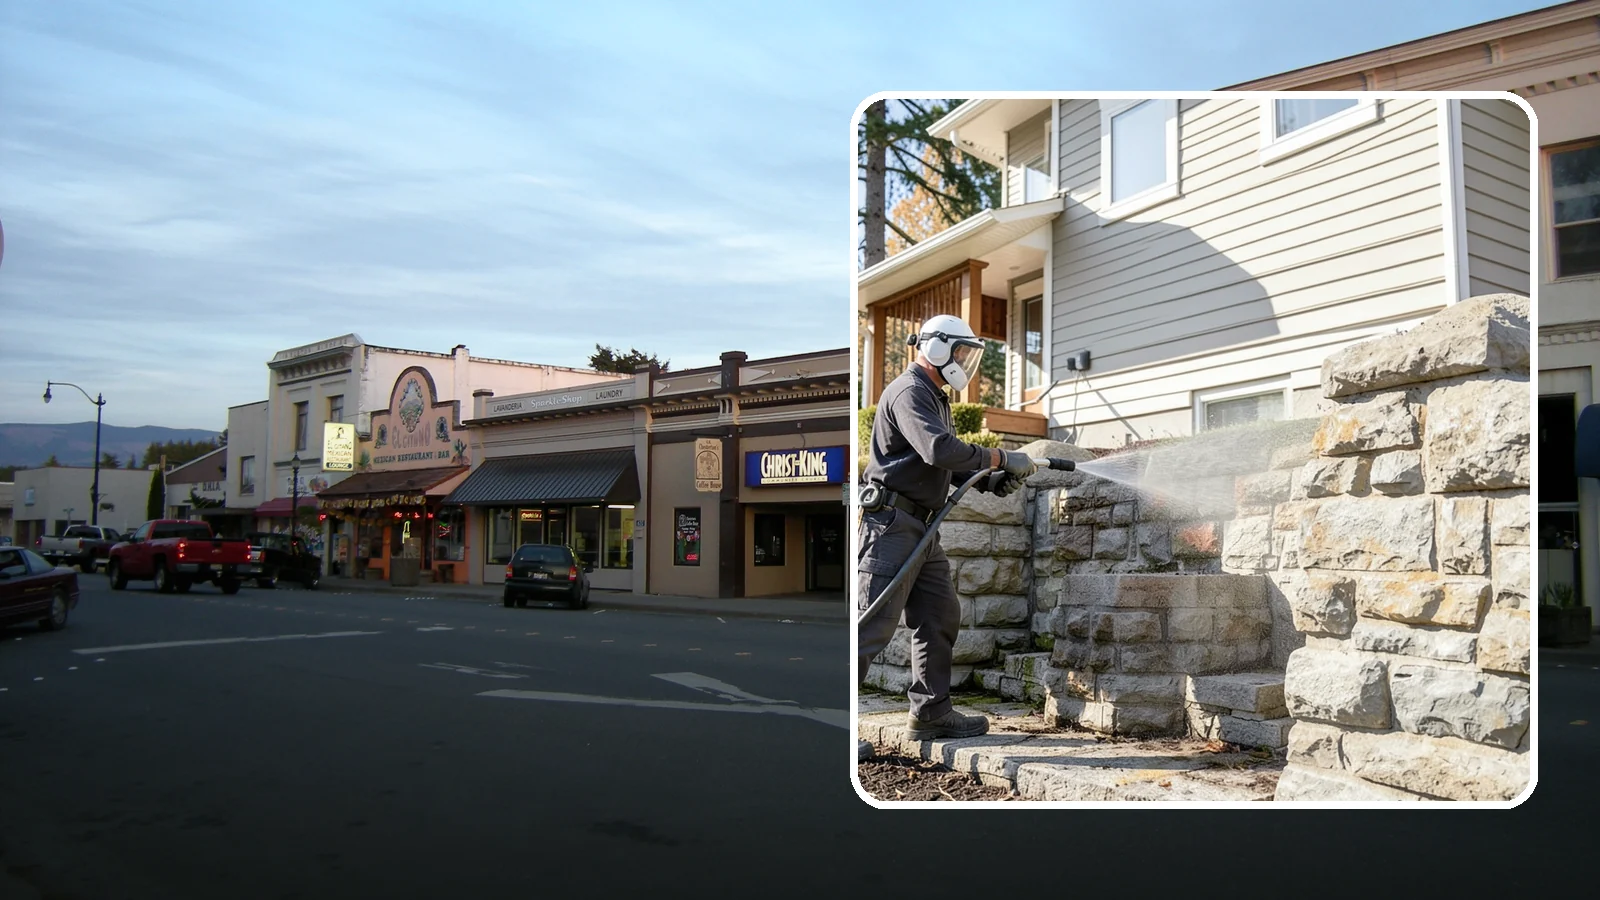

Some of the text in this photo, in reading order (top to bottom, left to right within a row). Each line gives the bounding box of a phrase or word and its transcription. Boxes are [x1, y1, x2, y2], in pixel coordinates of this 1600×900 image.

[493, 389, 623, 413] LAVANDERIA Sparkle Shop LAUNDRY
[391, 425, 402, 449] EL
[374, 455, 396, 464] MEXICAN
[397, 451, 433, 462] RESTAURANT
[438, 450, 450, 459] BAR
[761, 450, 827, 478] CHRIST KING
